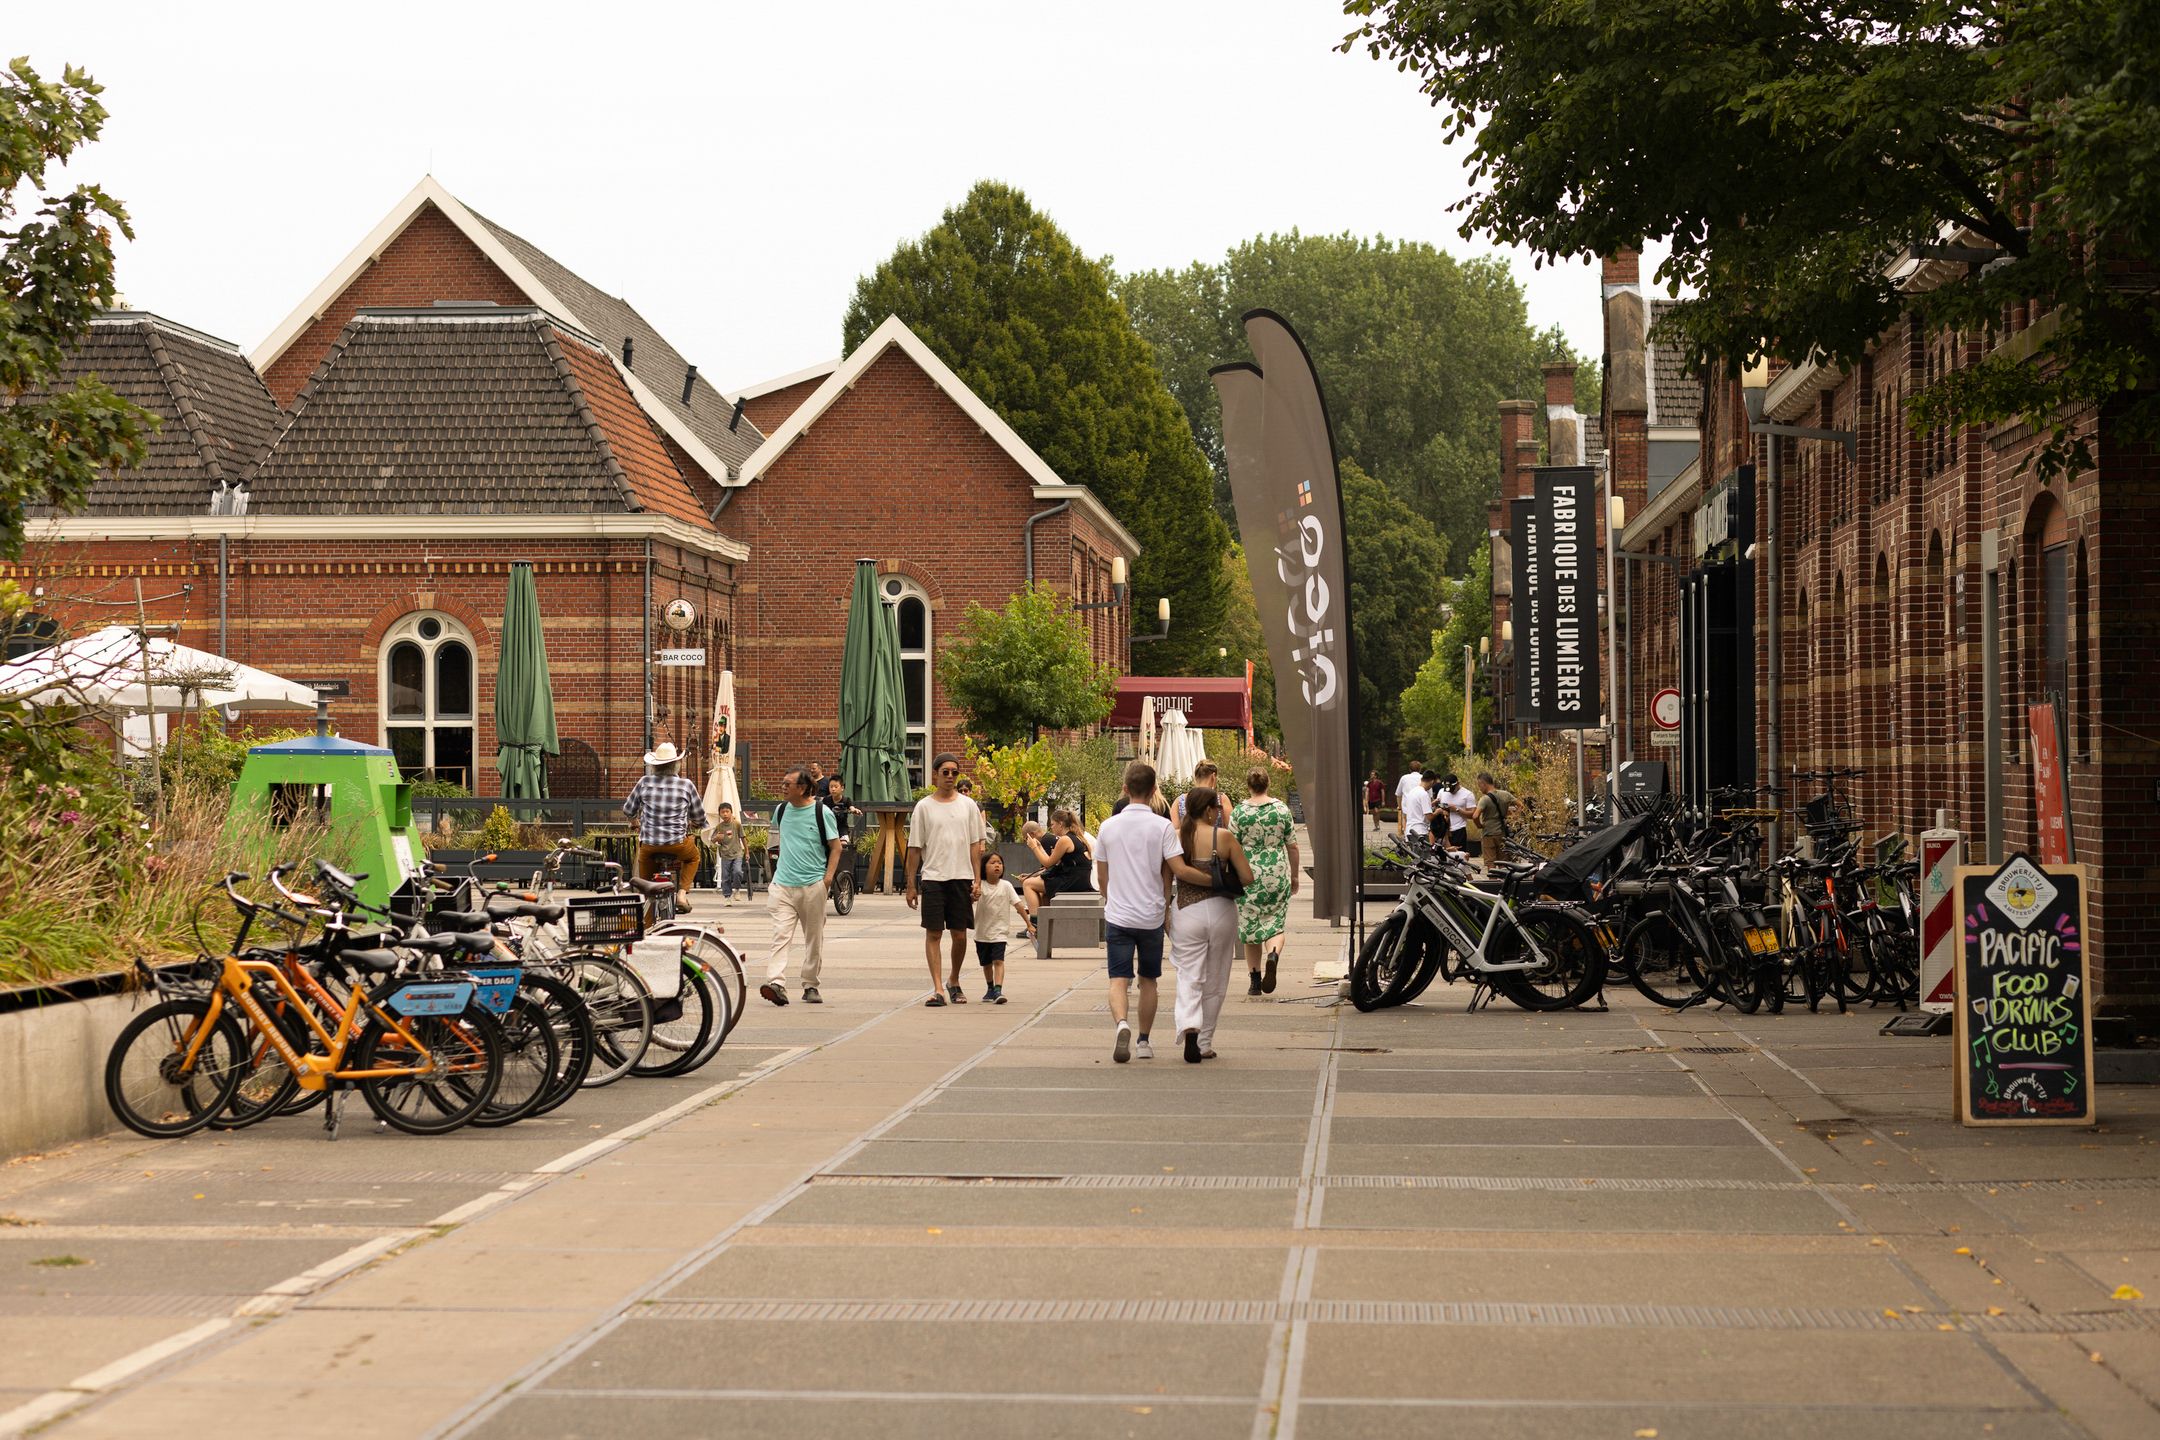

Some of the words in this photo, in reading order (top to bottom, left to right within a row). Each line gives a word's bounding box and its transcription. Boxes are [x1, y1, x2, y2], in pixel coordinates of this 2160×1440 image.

[1552, 485, 1578, 580] FABRIQUE
[1557, 585, 1576, 613] DES
[1556, 617, 1584, 711] LUMIÈRES
[1152, 697, 1193, 712] CANTINE
[2003, 904, 2040, 916] AMSTERDAM
[494, 977, 514, 985] DAG!
[1993, 970, 2049, 998] FOOD
[240, 990, 272, 1027] DONKEY
[267, 1025, 302, 1067] REPUBLIC
[1992, 1028, 2062, 1056] CLUB
